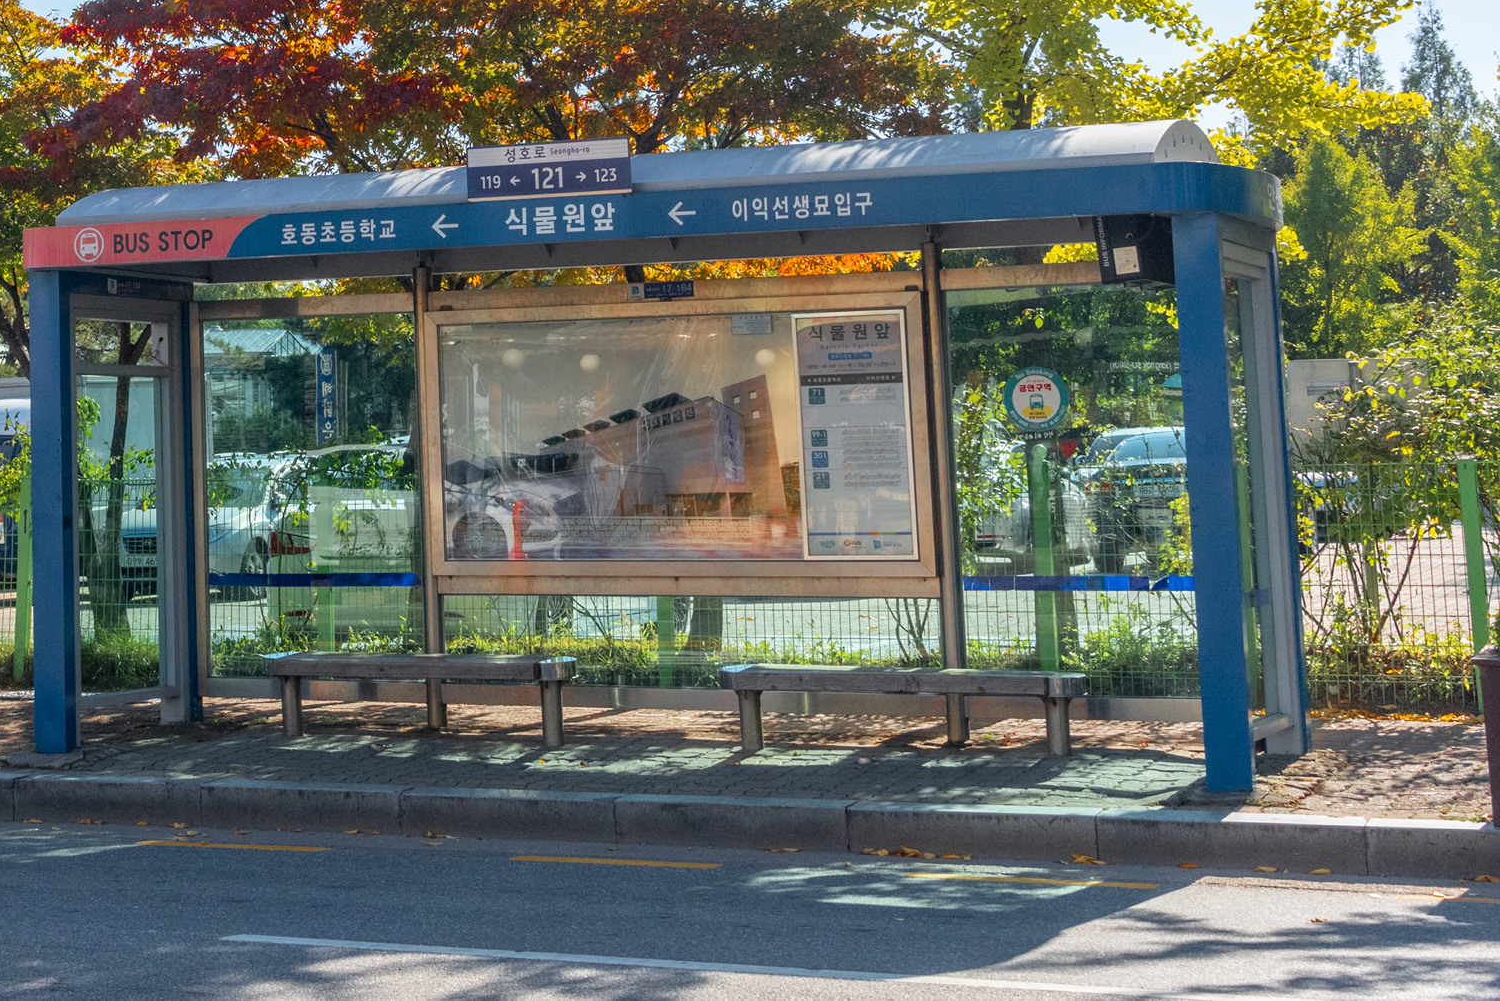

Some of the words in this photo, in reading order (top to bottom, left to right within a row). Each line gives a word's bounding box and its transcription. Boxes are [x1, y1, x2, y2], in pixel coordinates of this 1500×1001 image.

[504, 146, 546, 162] 성호로
[550, 146, 590, 157] Seongho-ro
[480, 175, 501, 190] 119
[531, 166, 564, 190] 121
[594, 167, 617, 183] 123
[731, 192, 873, 222] 이익선생묘입구
[504, 202, 616, 236] 식물원앞
[280, 218, 396, 245] 호동초등학교
[113, 232, 150, 254] BUS
[157, 229, 213, 252] STOP
[808, 322, 891, 342] 식물원앞
[1025, 369, 1054, 379] Smoking
[811, 389, 822, 397] 71
[1019, 383, 1052, 393] 금연구역
[813, 451, 827, 460] 301
[816, 472, 826, 480] 21
